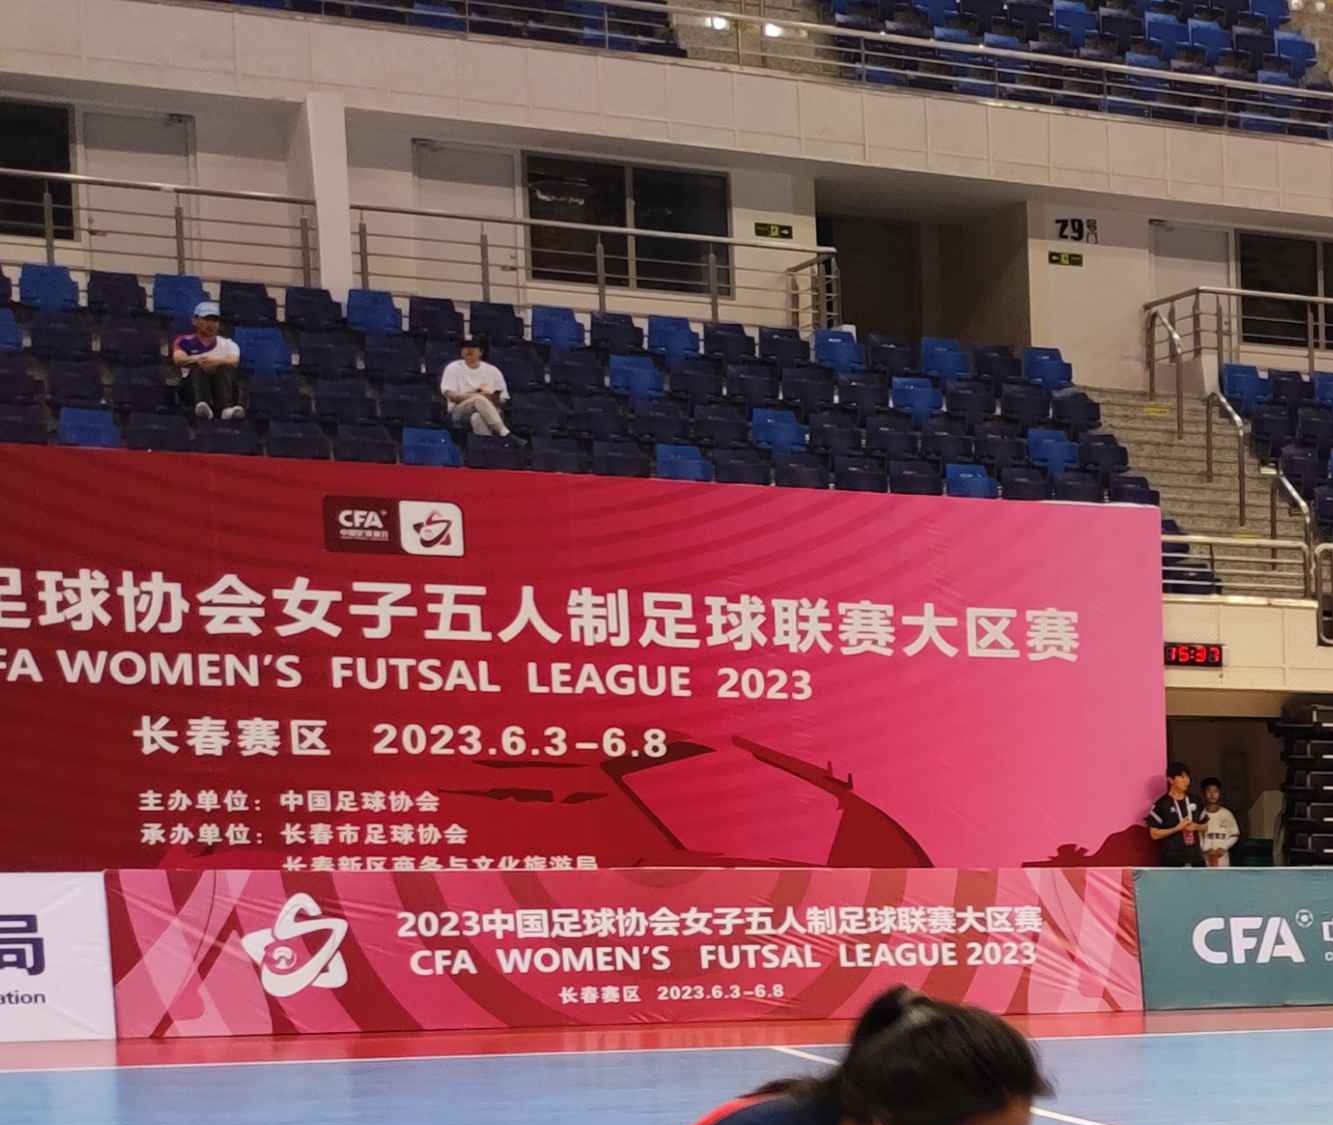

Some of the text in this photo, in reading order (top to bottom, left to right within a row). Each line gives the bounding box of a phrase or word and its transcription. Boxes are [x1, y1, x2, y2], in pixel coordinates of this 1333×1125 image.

[1055, 218, 1083, 241] 29
[338, 509, 384, 529] CFA
[57, 649, 303, 688] WOMEN'S
[331, 657, 500, 693] FUTSAL
[528, 662, 692, 697] LEAGUE
[716, 667, 812, 701] 2023
[132, 716, 331, 757] 长春赛区
[398, 905, 1044, 939] 2023中国足球协会女子五人制足球联赛大区赛
[1192, 915, 1305, 965] CFA
[410, 941, 1037, 976] CFA WOMEN'S FUTSAL LEAGUE 2023
[559, 985, 640, 1004] 长春赛区
